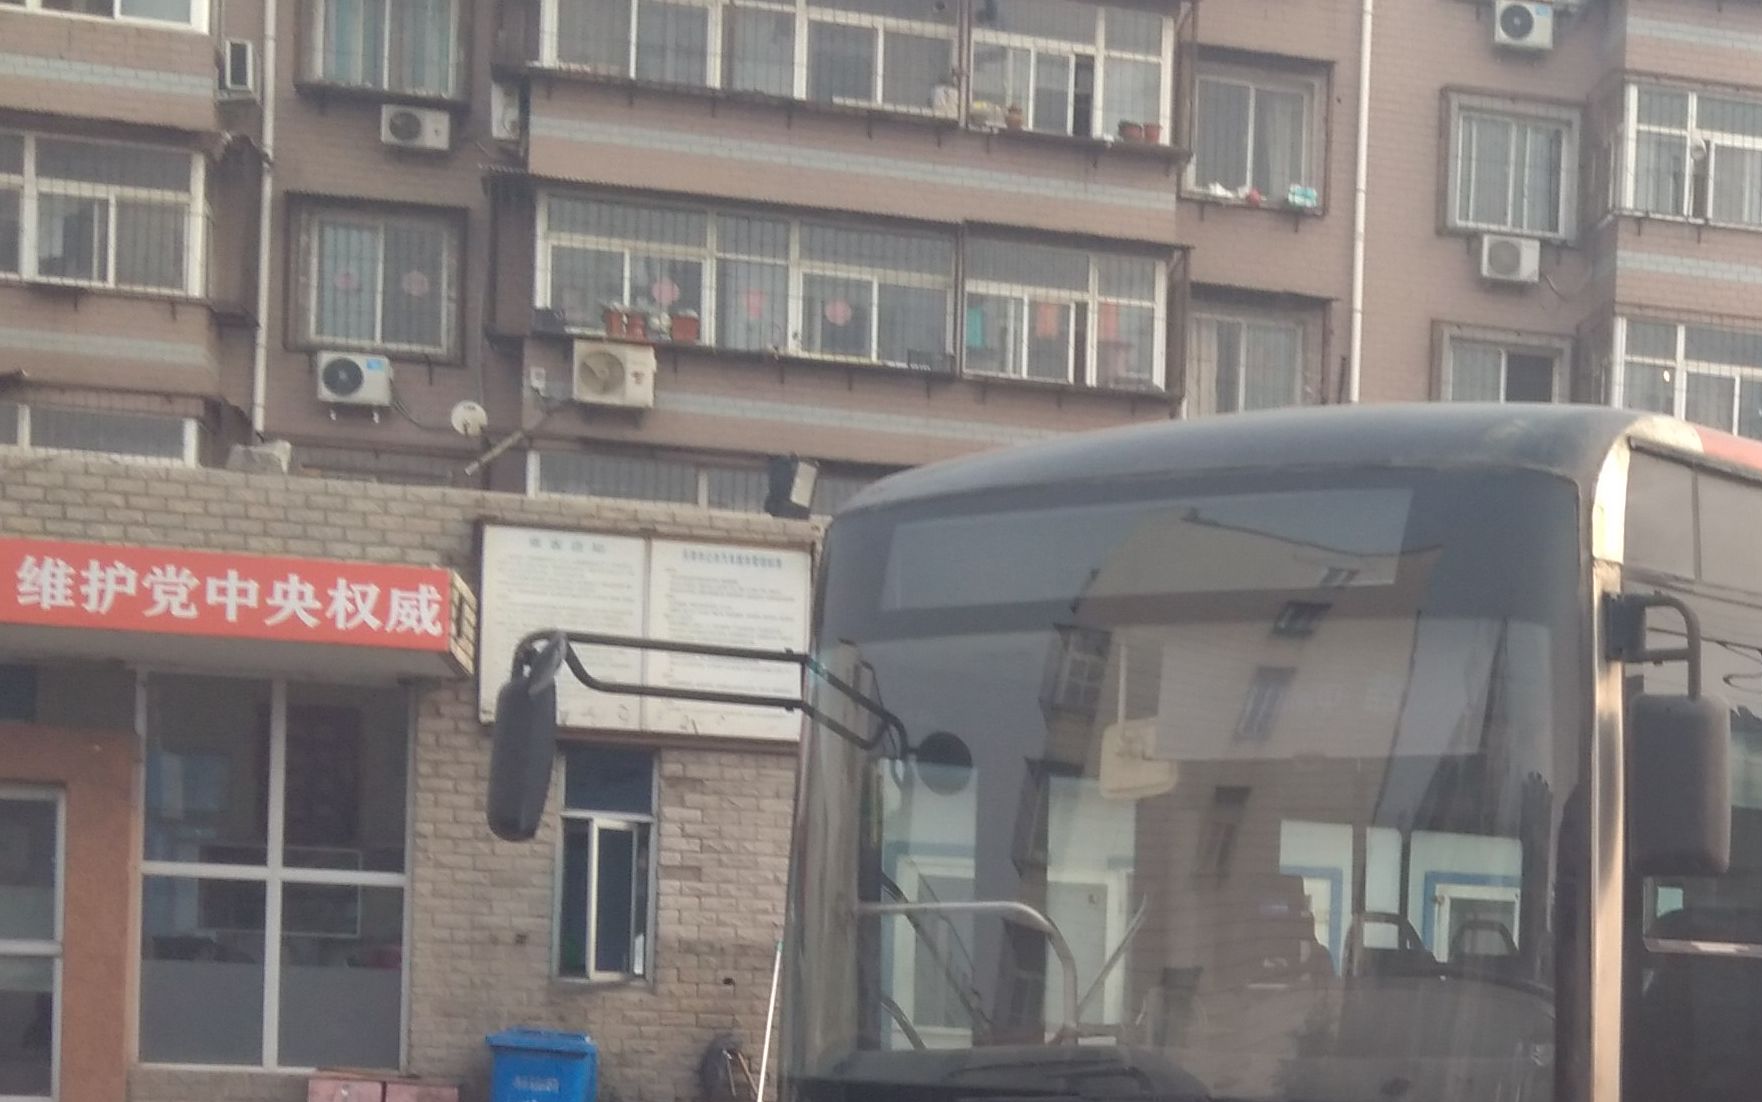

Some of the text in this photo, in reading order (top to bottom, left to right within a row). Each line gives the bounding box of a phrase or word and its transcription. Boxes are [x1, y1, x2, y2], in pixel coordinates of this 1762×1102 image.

[16, 556, 443, 636] 维护党中央权威
